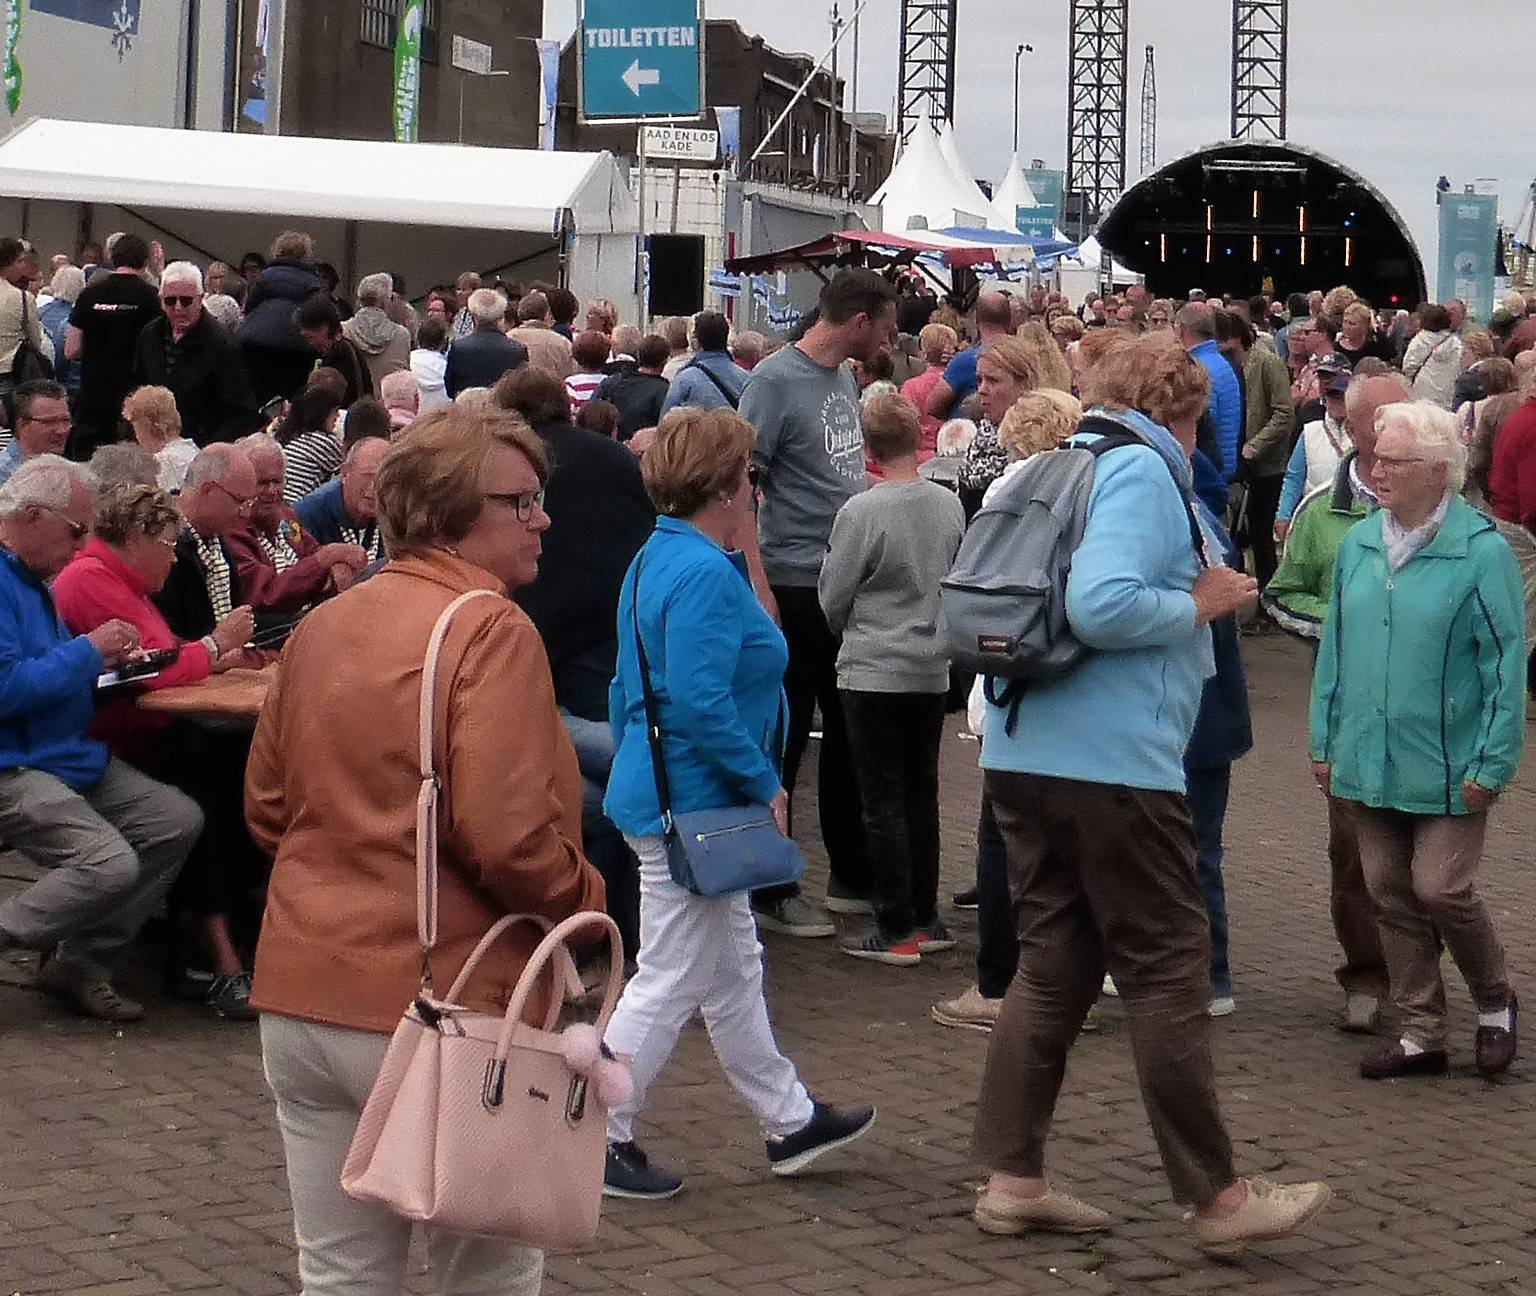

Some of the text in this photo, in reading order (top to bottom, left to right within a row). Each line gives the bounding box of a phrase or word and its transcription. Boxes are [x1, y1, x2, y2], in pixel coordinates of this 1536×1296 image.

[585, 27, 694, 48] TOILETTEN
[645, 130, 715, 142] AAD EN LOS
[662, 141, 692, 151] KADE
